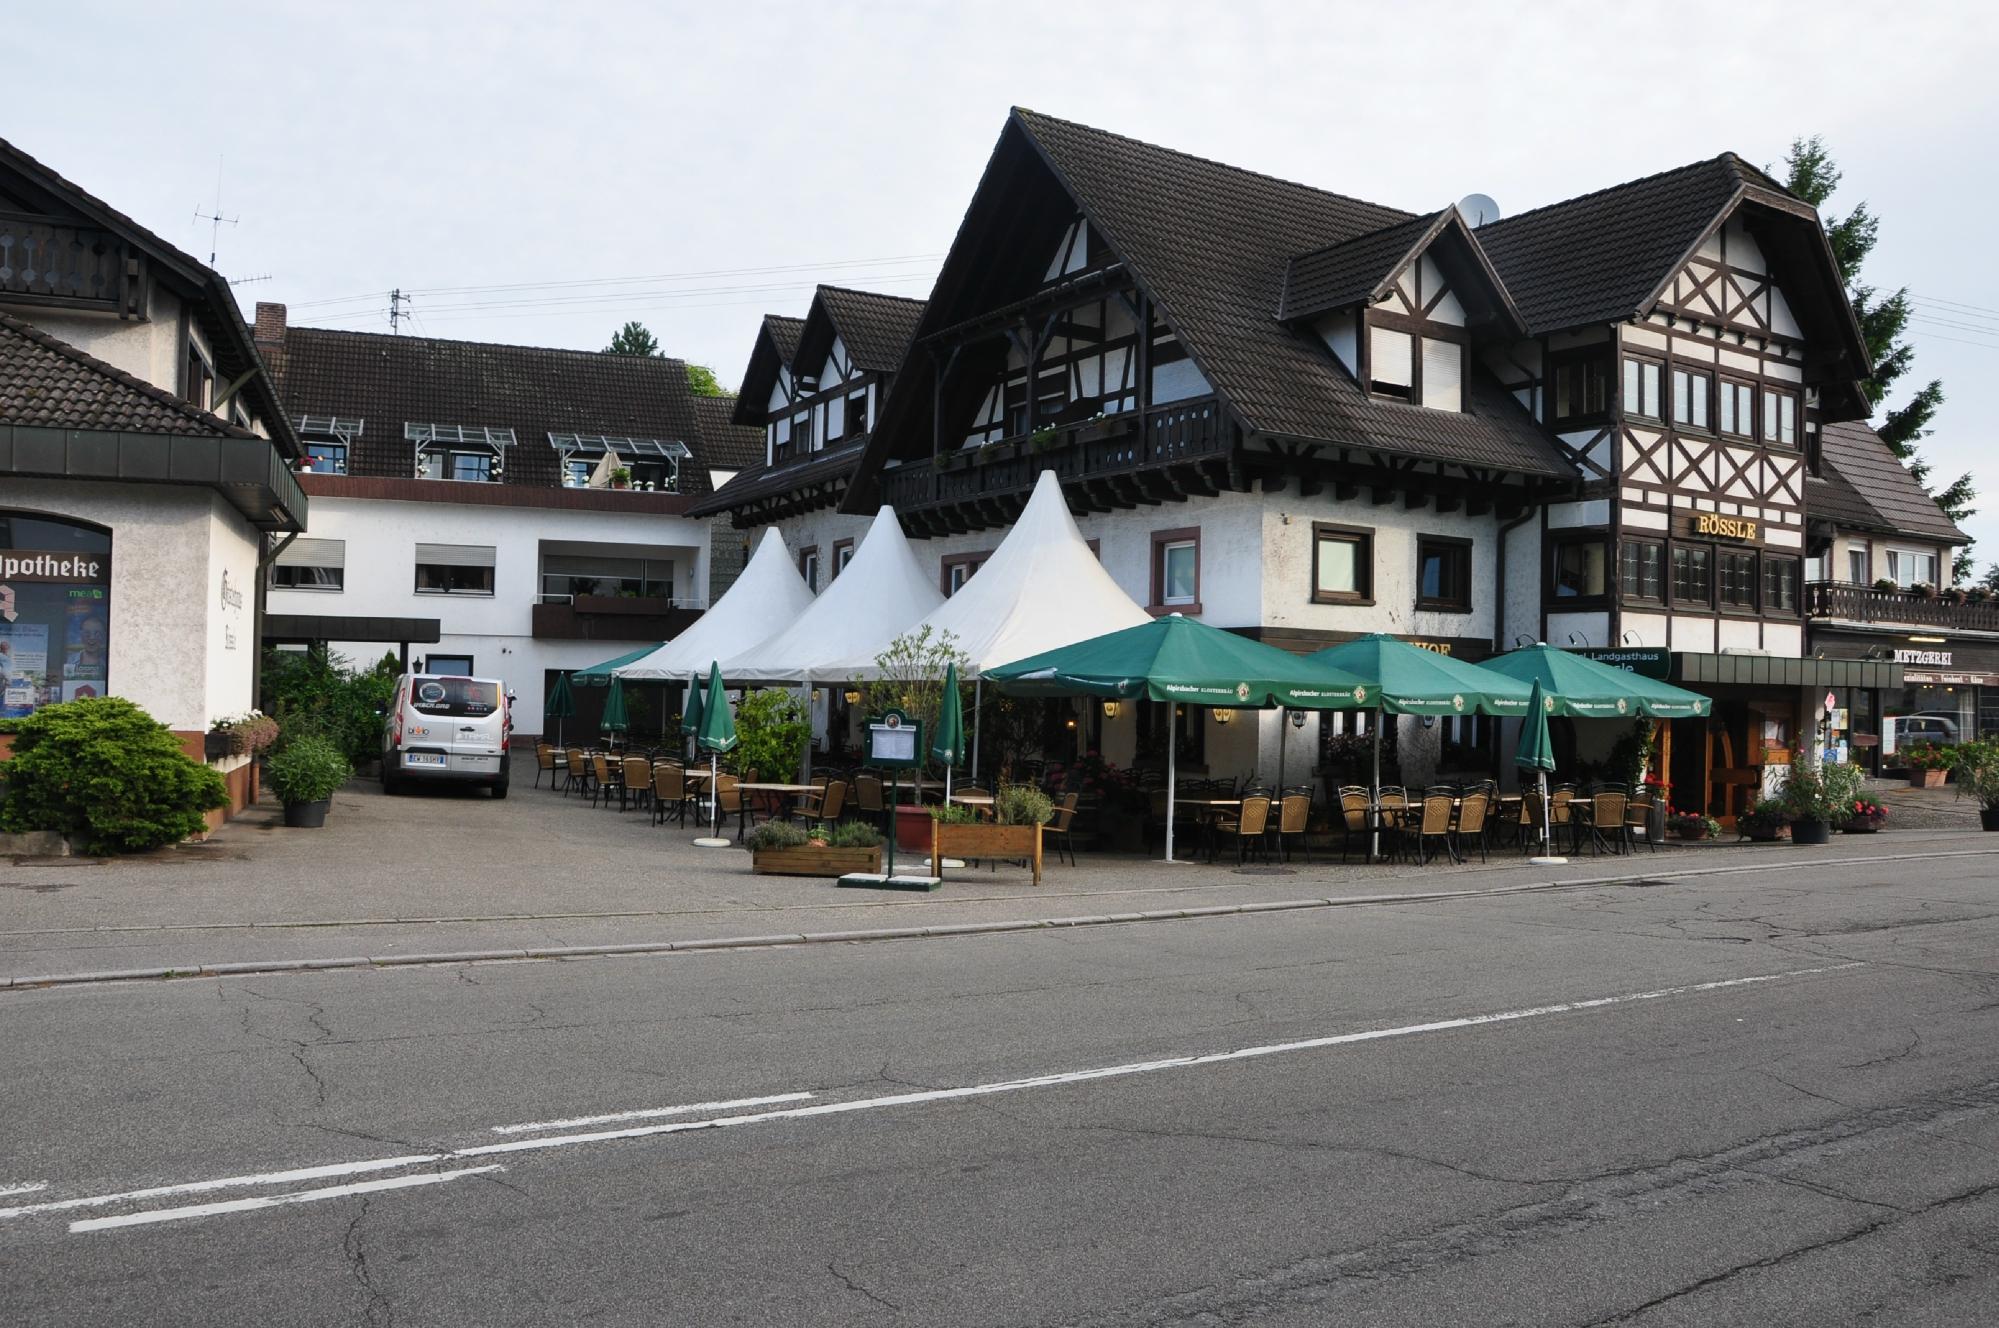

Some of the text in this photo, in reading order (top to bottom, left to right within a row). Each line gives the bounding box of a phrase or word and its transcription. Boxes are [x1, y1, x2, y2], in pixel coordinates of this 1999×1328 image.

[1698, 514, 1756, 540] RÖSSLE
[0, 555, 99, 579] potheke
[1591, 652, 1659, 662] Landgasthaus
[1893, 649, 1953, 667] METZGEREI
